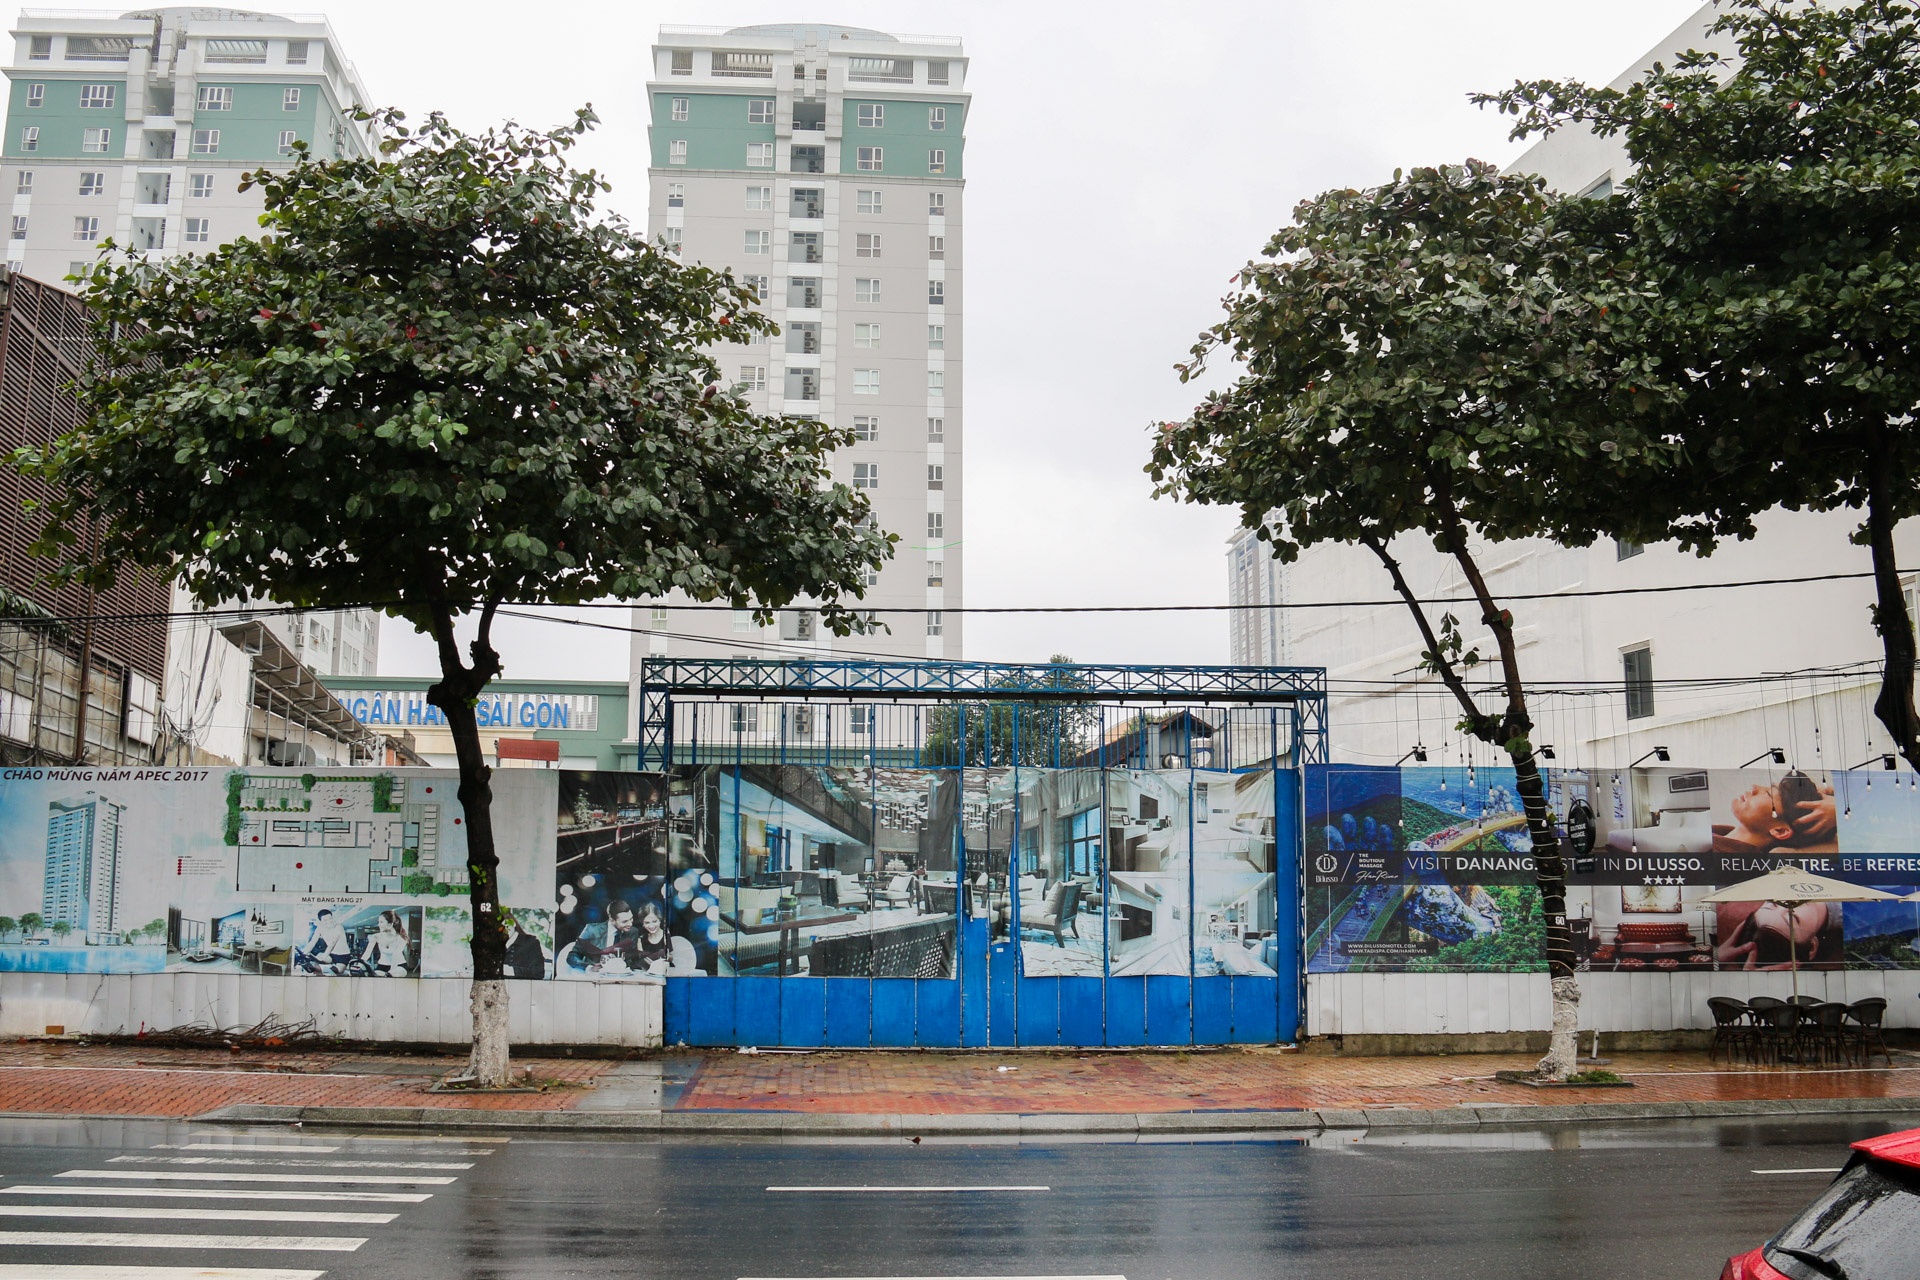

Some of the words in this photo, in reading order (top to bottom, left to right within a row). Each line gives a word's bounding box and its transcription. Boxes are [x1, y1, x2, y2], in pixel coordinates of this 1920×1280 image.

[476, 694, 512, 726] SÀI
[520, 695, 568, 727] GÒN
[3, 767, 43, 780] CHÀO
[47, 767, 93, 782] MỪNG
[96, 768, 131, 781] NĂM
[134, 770, 171, 781] APEC
[174, 770, 208, 782] 2017
[1407, 857, 1451, 871] VISIT
[1456, 857, 1538, 871] DANANG.
[1603, 858, 1620, 871] IN
[1625, 858, 1642, 871] DI
[1648, 858, 1705, 871] LUSSO.
[1721, 858, 1771, 871] RELAX
[1775, 859, 1795, 870] AT
[1799, 858, 1835, 871] TRE.
[1843, 858, 1862, 871] BE
[480, 902, 492, 912] 62
